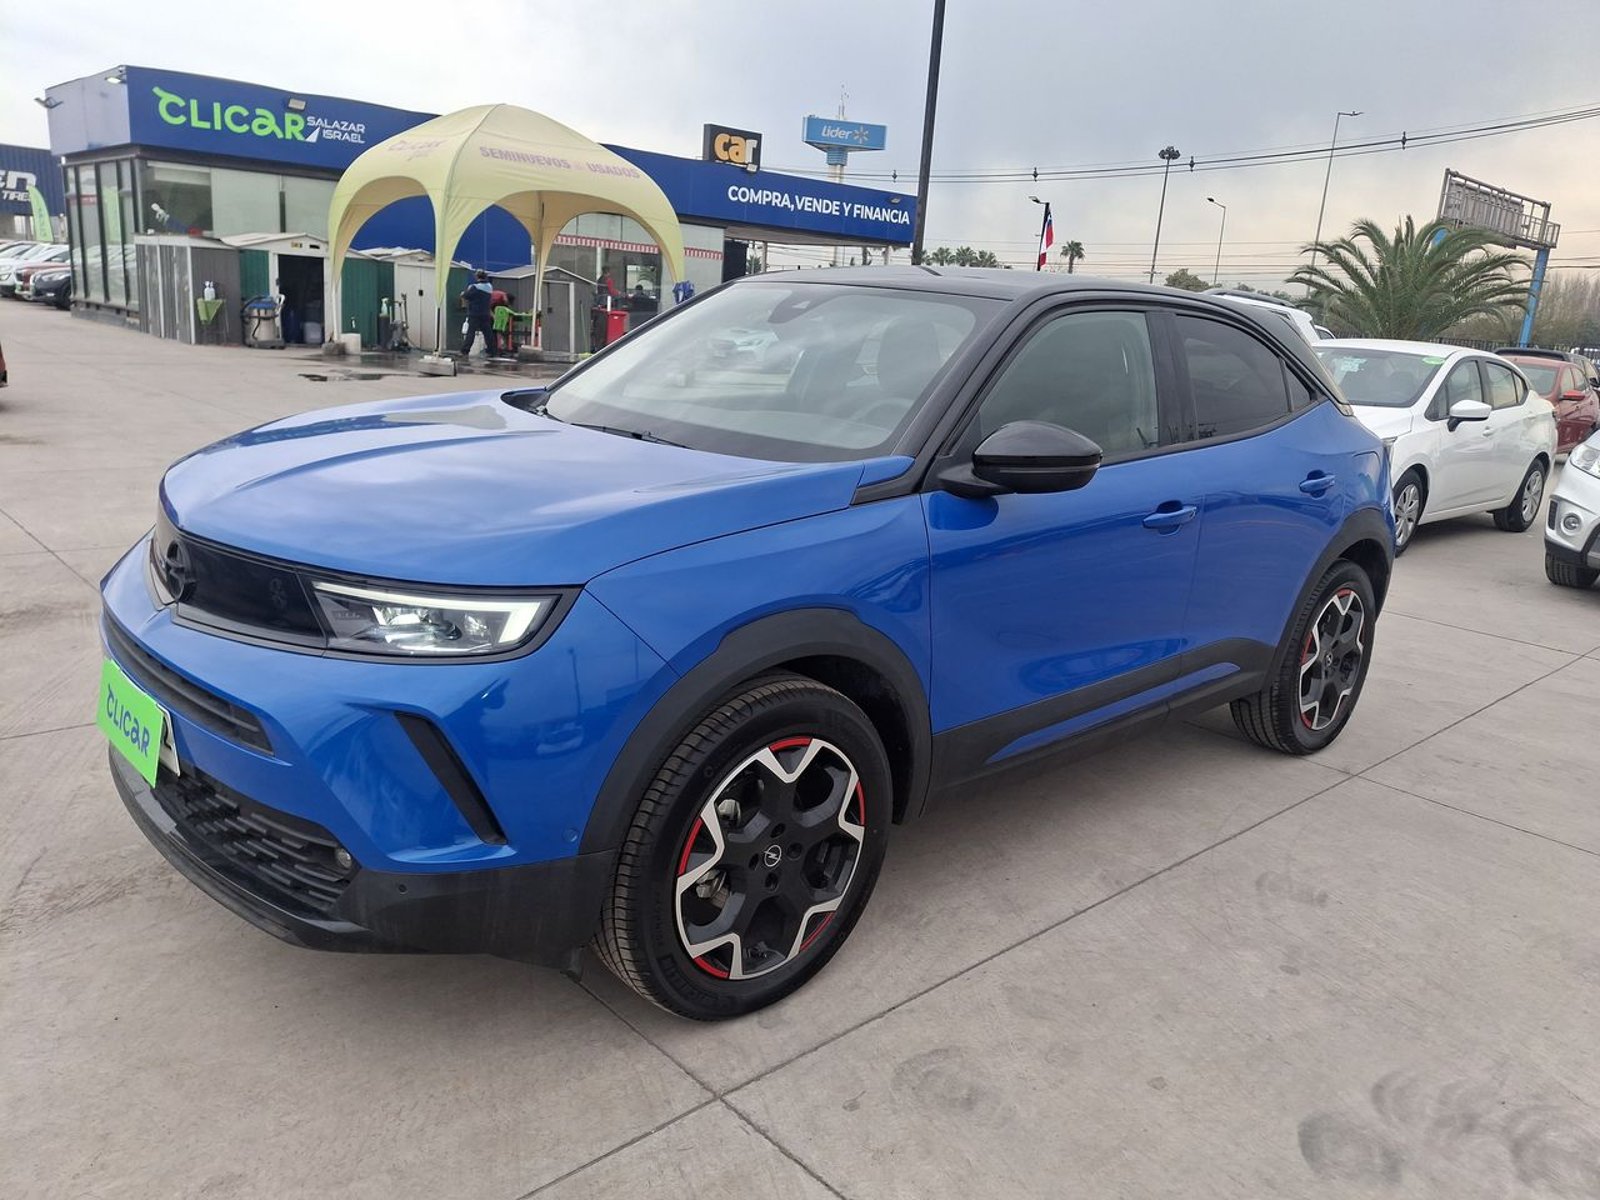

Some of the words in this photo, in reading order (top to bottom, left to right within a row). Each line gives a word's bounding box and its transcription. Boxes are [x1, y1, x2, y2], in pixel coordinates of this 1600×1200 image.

[307, 116, 366, 134] SALAZAR
[322, 128, 366, 144] ISRAEL
[479, 146, 572, 170] SEMINUEVOS
[713, 132, 759, 164] car
[587, 161, 640, 179] USADOS
[795, 194, 840, 216] VENDE
[842, 202, 852, 217] Y
[853, 204, 911, 225] FINANCIA
